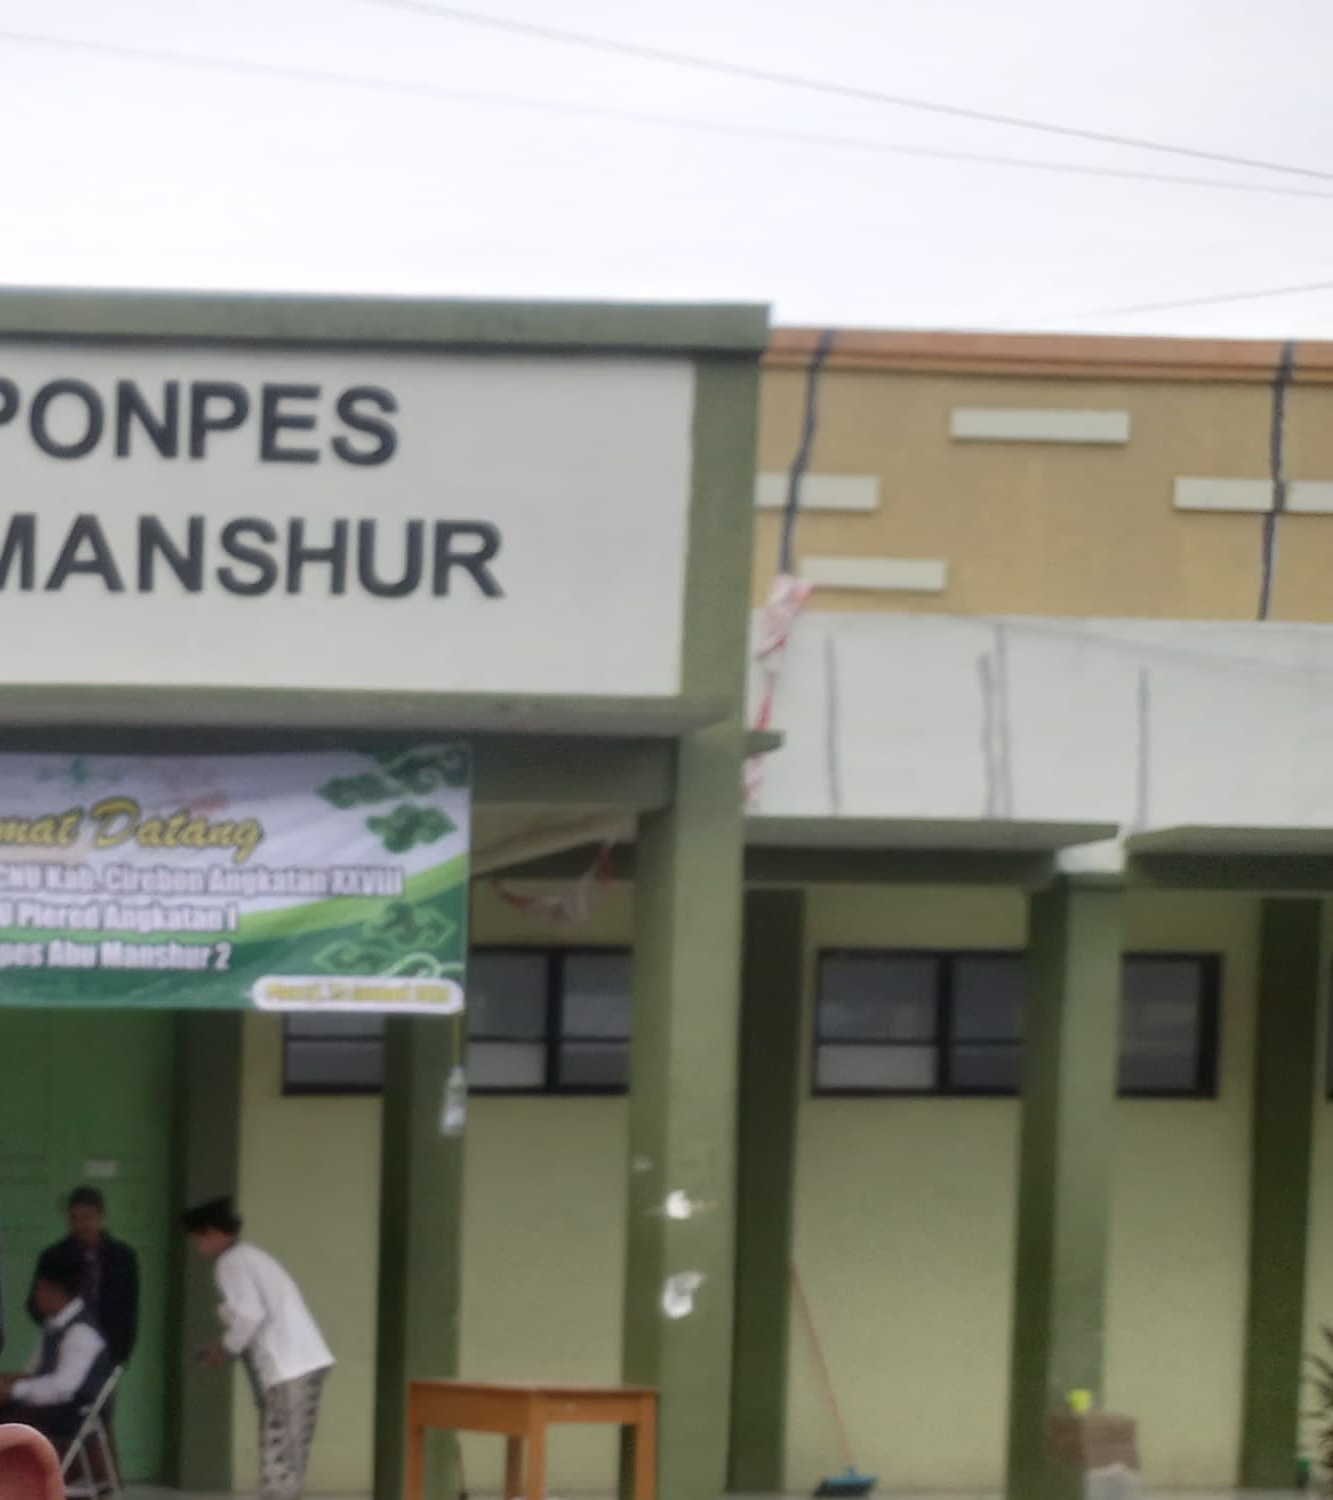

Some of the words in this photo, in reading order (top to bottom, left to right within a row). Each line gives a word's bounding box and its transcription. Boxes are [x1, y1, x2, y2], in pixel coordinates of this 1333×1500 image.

[90, 796, 263, 860] Datang
[47, 939, 98, 968] Abu
[100, 940, 213, 970] Manshur
[216, 941, 232, 970] 2
